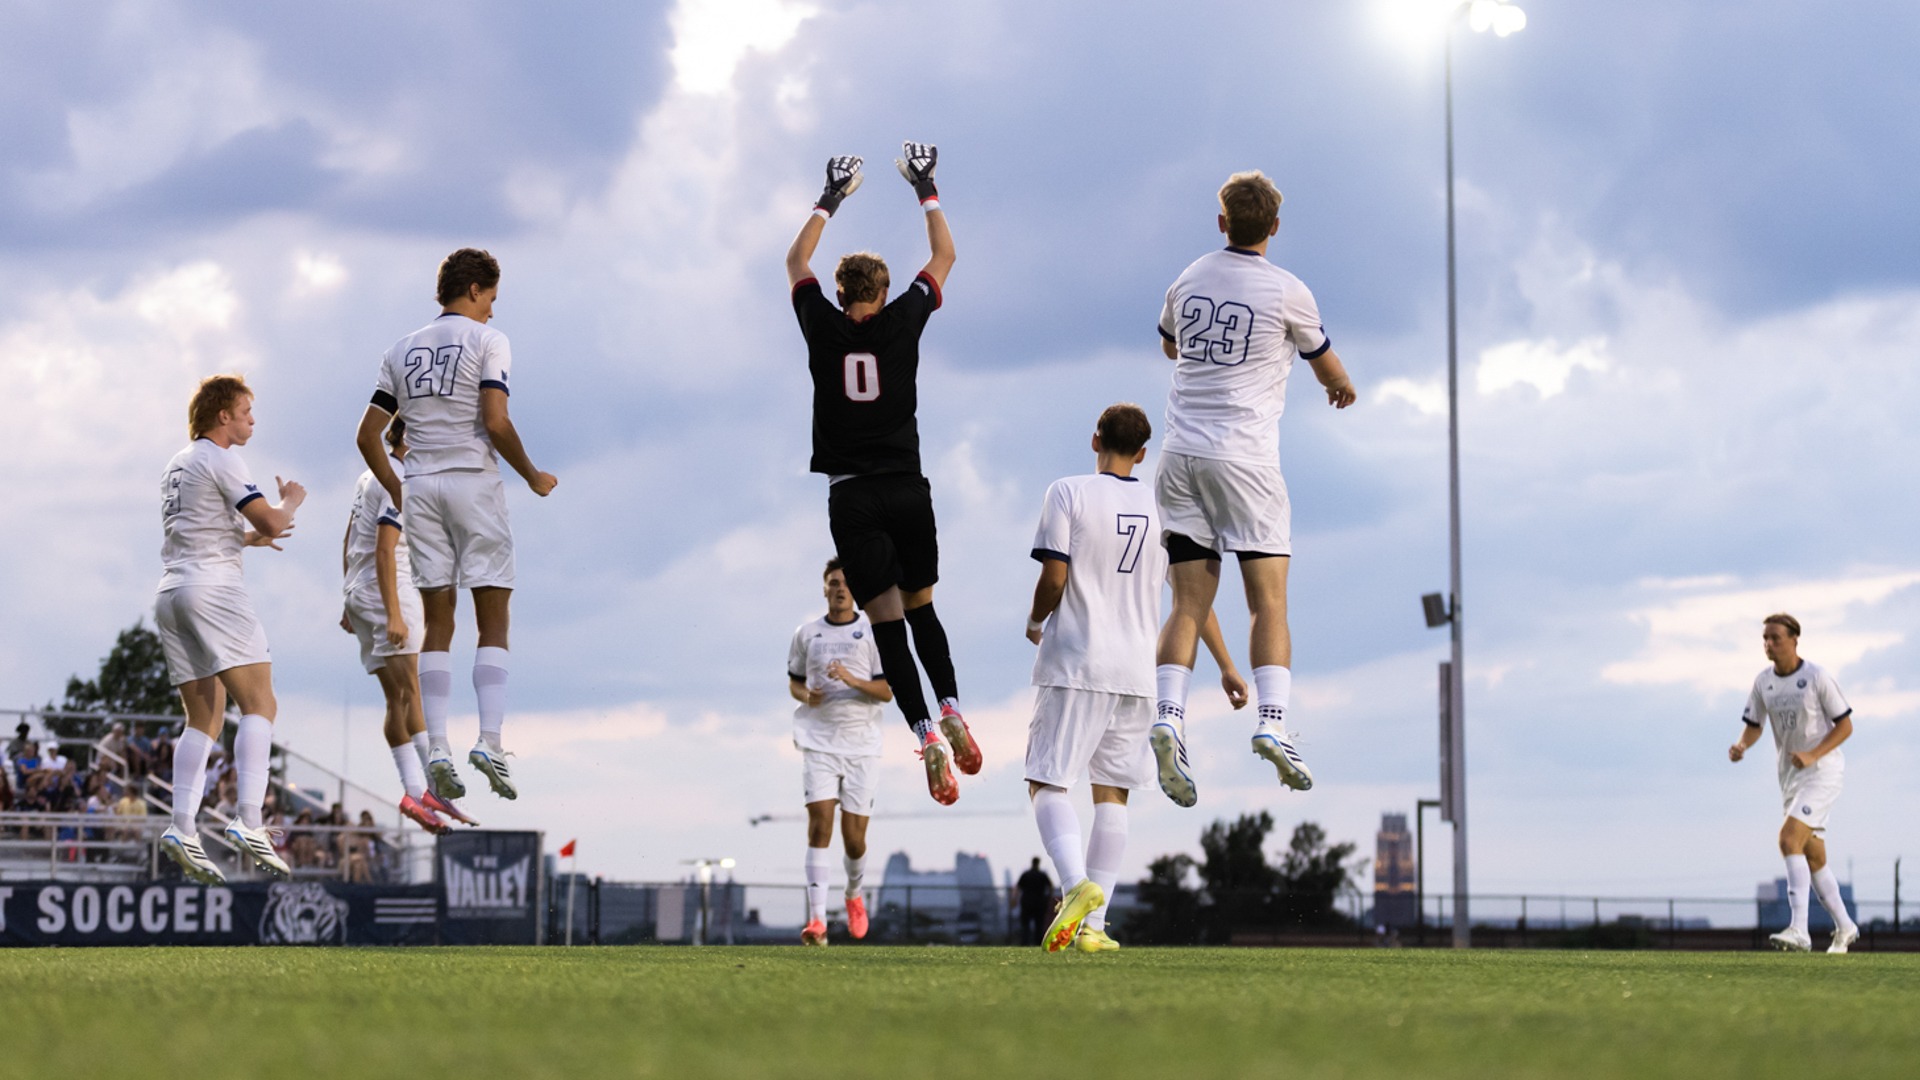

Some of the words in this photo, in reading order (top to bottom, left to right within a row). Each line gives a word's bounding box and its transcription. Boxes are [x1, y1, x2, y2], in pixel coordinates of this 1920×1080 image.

[1180, 295, 1254, 366] 23
[405, 345, 462, 399] 27
[843, 351, 881, 402] 0
[1117, 514, 1149, 573] 7
[443, 855, 530, 908] VALLEY
[37, 885, 234, 933] SOCCER
